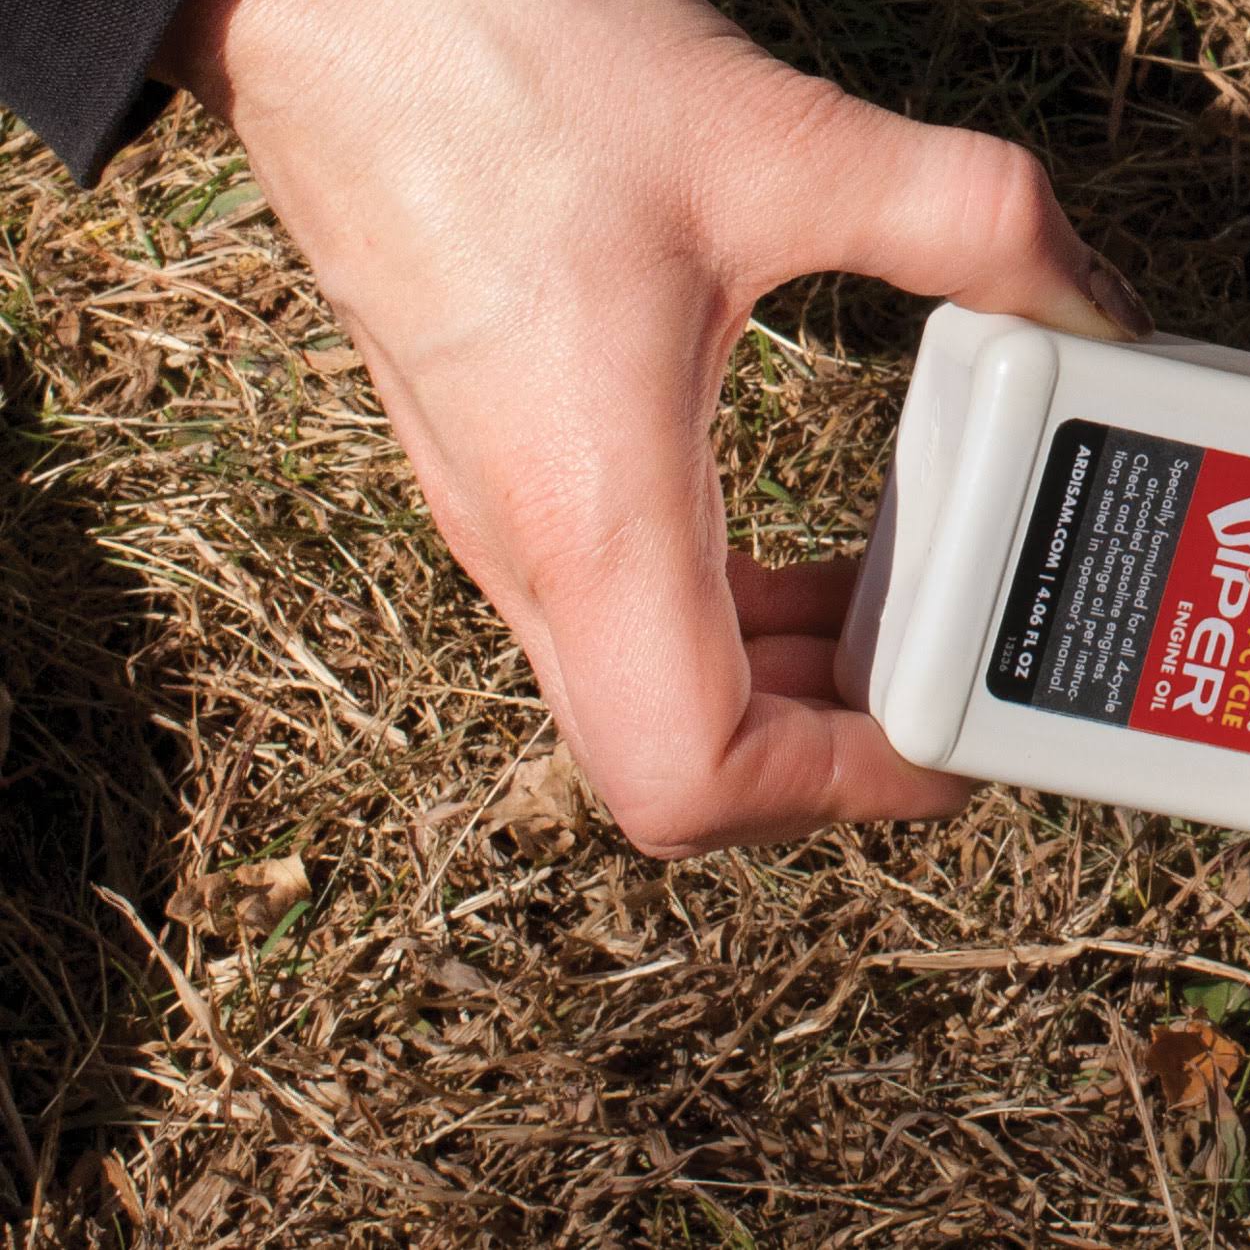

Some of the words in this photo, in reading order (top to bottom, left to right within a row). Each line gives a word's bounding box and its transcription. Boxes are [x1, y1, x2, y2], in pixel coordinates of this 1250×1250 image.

[1107, 450, 1128, 485] tions
[1122, 453, 1149, 500] Check
[1045, 444, 1091, 568] ARDISAM.COM
[1093, 489, 1114, 535] stated
[1129, 477, 1159, 553] air-cooled
[1153, 458, 1189, 527] Specially
[1113, 504, 1130, 535] and
[1087, 538, 1104, 552] in
[1095, 537, 1121, 593] change
[1110, 554, 1136, 618] gasoline
[1133, 529, 1169, 610] formulated
[1029, 587, 1051, 626] 4.06
[1089, 597, 1105, 618] oil
[1126, 613, 1146, 635] for
[1022, 630, 1040, 647] FL
[1082, 619, 1097, 647] per
[1091, 622, 1117, 683] engines.
[1119, 637, 1136, 658] all
[1160, 600, 1193, 675] ENGINE
[1014, 652, 1033, 679] OZ
[1047, 634, 1072, 694] manual.
[1067, 650, 1093, 702] instruc-
[1104, 660, 1130, 713] 4-cycle
[1150, 680, 1171, 711] OIL
